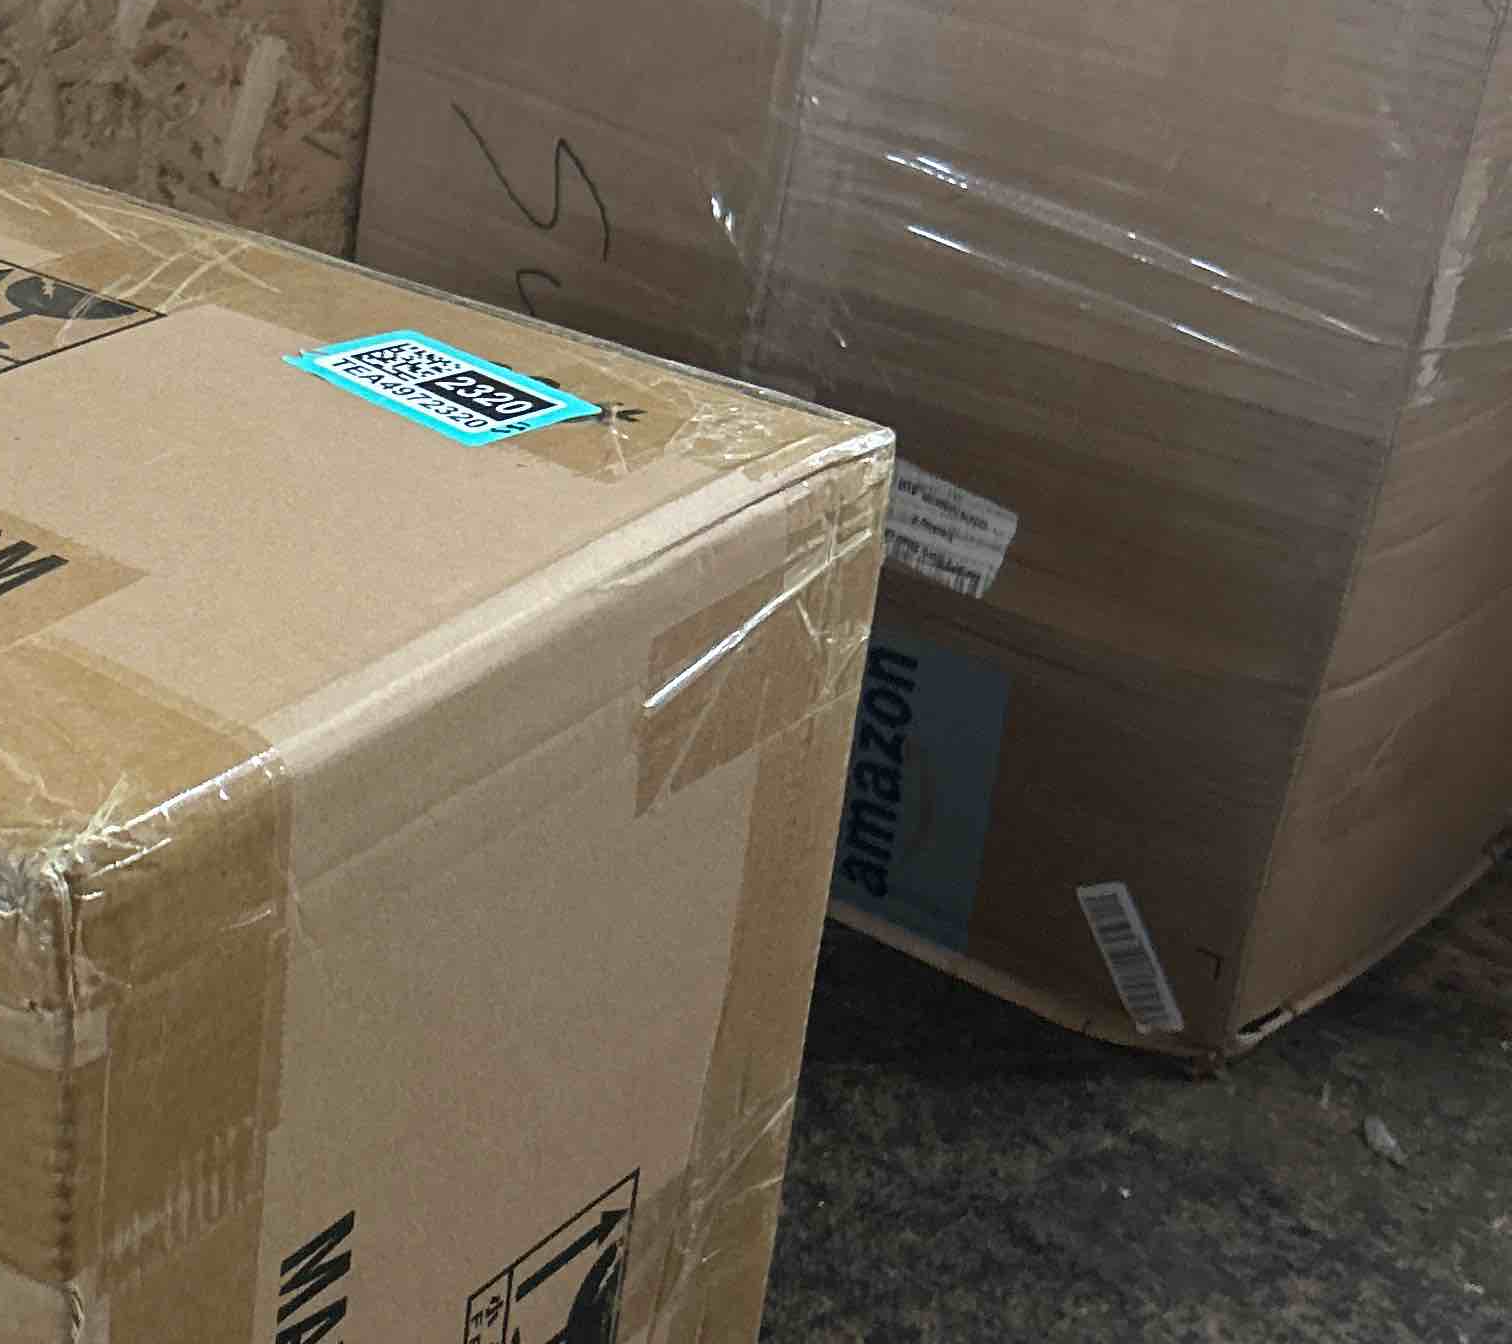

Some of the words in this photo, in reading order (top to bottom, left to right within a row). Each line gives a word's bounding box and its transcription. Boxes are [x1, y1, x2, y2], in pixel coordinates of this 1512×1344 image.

[331, 357, 489, 429] TEA4972320
[434, 375, 534, 415] 2320
[842, 646, 918, 897] amazon
